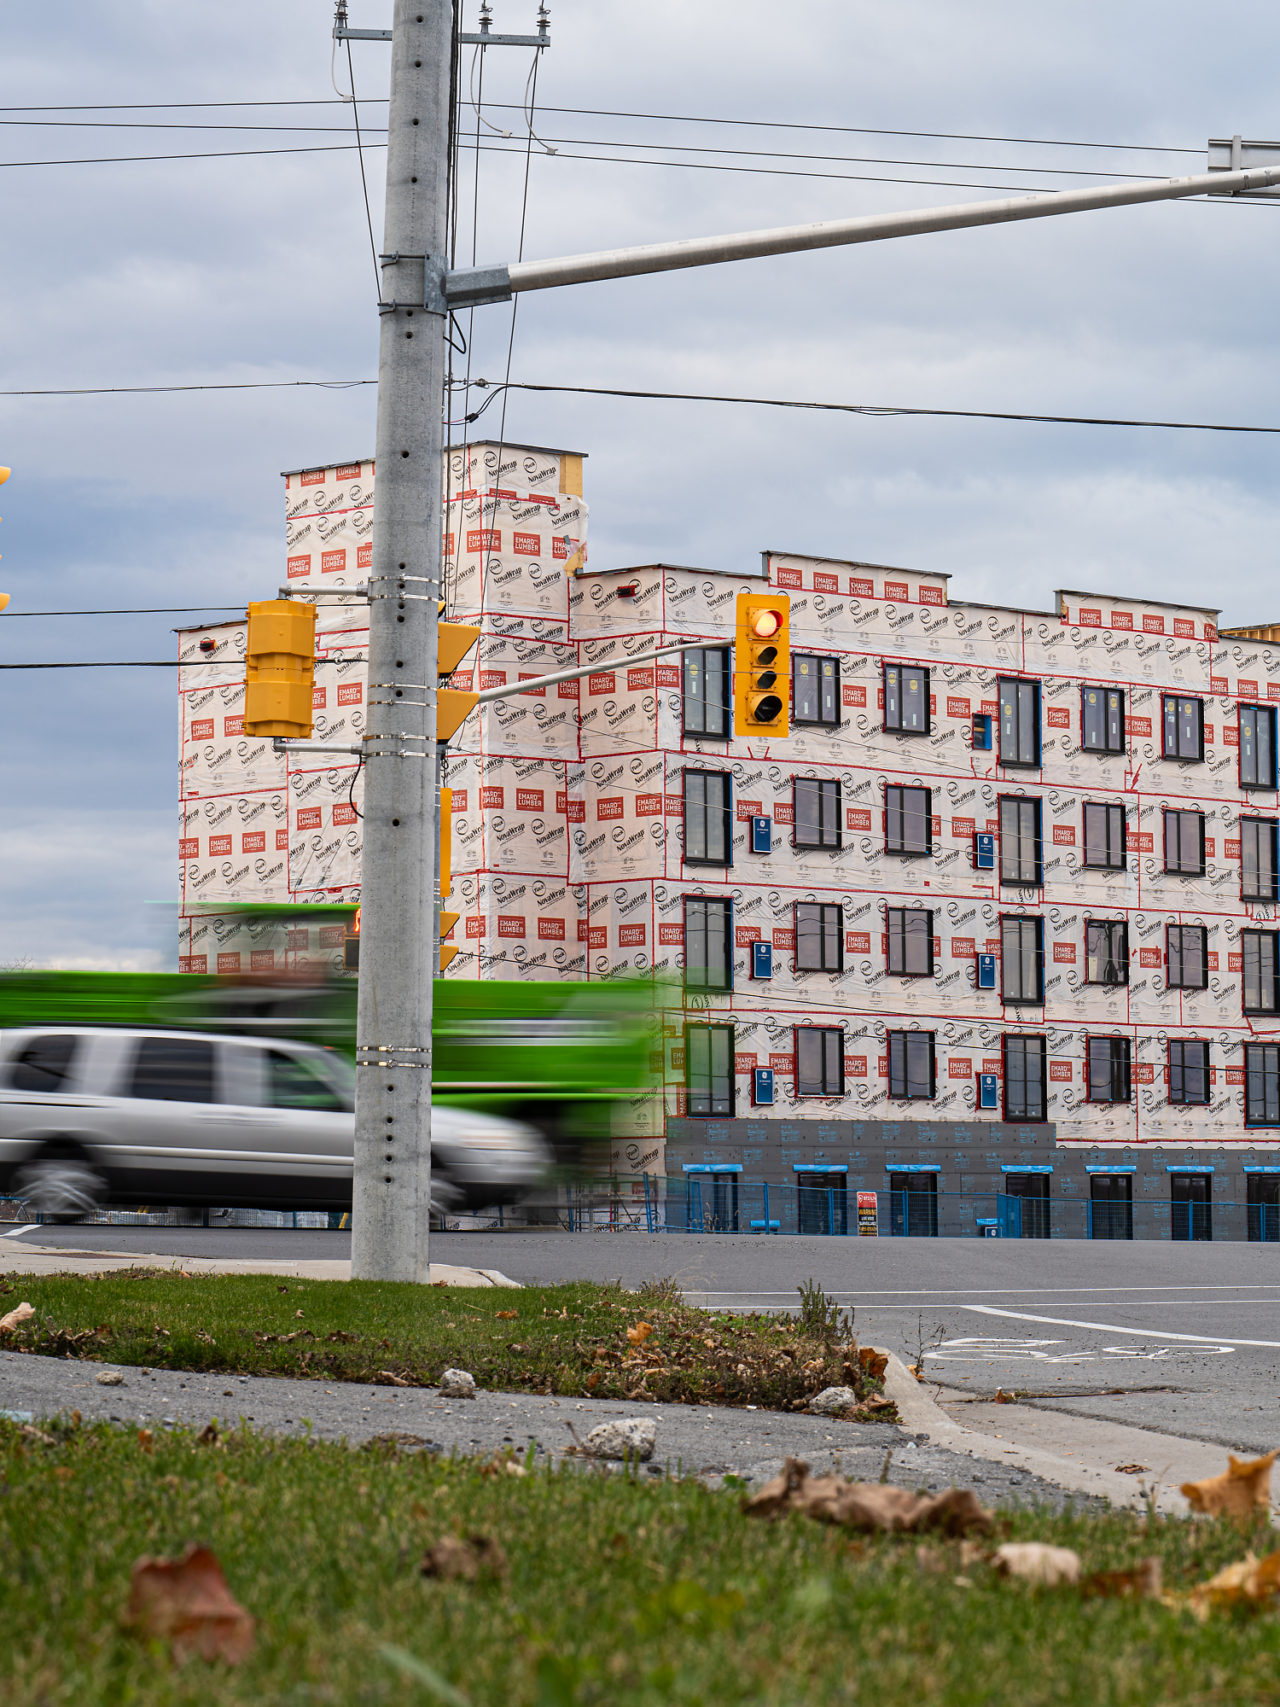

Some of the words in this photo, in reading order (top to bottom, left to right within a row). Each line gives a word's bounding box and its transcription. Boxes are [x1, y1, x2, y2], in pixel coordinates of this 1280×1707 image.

[528, 467, 556, 482] NovaWrap
[321, 520, 346, 540] NovaWrap
[515, 537, 534, 545] EMARD
[516, 543, 538, 552] LUMBER
[289, 559, 306, 568] EMARD
[323, 553, 340, 562] EMARD
[323, 559, 344, 569] LUMBER
[289, 564, 309, 574] LUMBER
[494, 568, 521, 583] NovaWrap
[533, 572, 560, 588] NovaWrap
[779, 577, 800, 586] LUMBER
[815, 576, 833, 584] EMARD
[815, 582, 836, 591] LUMBER
[669, 586, 696, 602] NovaWrap
[886, 585, 903, 593] EMARD
[886, 591, 907, 599] LUMBER
[921, 589, 938, 597] EMARD
[707, 591, 733, 606] NovaWrap
[921, 595, 942, 603] LUMBER
[818, 604, 843, 619] NovaWrap
[854, 609, 879, 623] NovaWrap
[889, 613, 913, 628] NovaWrap
[924, 617, 948, 632] NovaWrap
[1081, 617, 1100, 625] LUMBER
[1113, 620, 1132, 628] LUMBER
[958, 621, 982, 635] NovaWrap
[992, 625, 1015, 640] NovaWrap
[1175, 628, 1193, 636] LUMBER
[589, 641, 615, 661] NovaWrap
[627, 636, 654, 656] NovaWrap
[591, 676, 609, 684] EMARD
[591, 682, 613, 691] LUMBER
[339, 687, 357, 695] EMARD
[339, 692, 360, 702] LUMBER
[845, 695, 865, 703] LUMBER
[949, 700, 965, 708] EMARD
[499, 708, 527, 725] NovaWrap
[609, 704, 635, 725] NovaWrap
[949, 706, 968, 714] LUMBER
[193, 723, 209, 731] EMARD
[538, 712, 566, 728] NovaWrap
[193, 728, 212, 737] LUMBER
[320, 719, 345, 739] NovaWrap
[208, 749, 231, 768] NovaWrap
[241, 745, 265, 764] NovaWrap
[596, 766, 623, 787] NovaWrap
[635, 762, 662, 783] NovaWrap
[737, 771, 762, 787] NovaWrap
[847, 780, 871, 796] NovaWrap
[519, 799, 542, 807] LUMBER
[638, 798, 656, 806] EMARD
[951, 789, 975, 805] NovaWrap
[242, 802, 265, 821] NovaWrap
[334, 806, 352, 815] EMARD
[599, 801, 618, 810] EMARD
[599, 807, 621, 816] LUMBER
[638, 803, 660, 812] LUMBER
[1053, 798, 1075, 813] NovaWrap
[209, 806, 232, 824] NovaWrap
[299, 811, 316, 820] EMARD
[299, 817, 320, 826] LUMBER
[335, 812, 356, 822] LUMBER
[244, 835, 260, 843] EMARD
[497, 824, 524, 841] NovaWrap
[536, 827, 564, 843] NovaWrap
[244, 841, 264, 849] LUMBER
[579, 834, 605, 855] NovaWrap
[617, 830, 644, 850] NovaWrap
[211, 844, 230, 852] LUMBER
[316, 839, 340, 859] NovaWrap
[193, 869, 216, 887] NovaWrap
[226, 866, 249, 884] NovaWrap
[259, 863, 283, 881] NovaWrap
[497, 885, 526, 903] NovaWrap
[537, 888, 565, 905] NovaWrap
[619, 892, 647, 912] NovaWrap
[847, 903, 871, 919] NovaWrap
[952, 909, 976, 925] NovaWrap
[500, 926, 524, 934] LUMBER
[1054, 915, 1077, 931] NovaWrap
[540, 928, 563, 936] LUMBER
[621, 928, 640, 936] EMARD
[621, 934, 644, 943] LUMBER
[631, 1148, 658, 1169] NovaWrap
